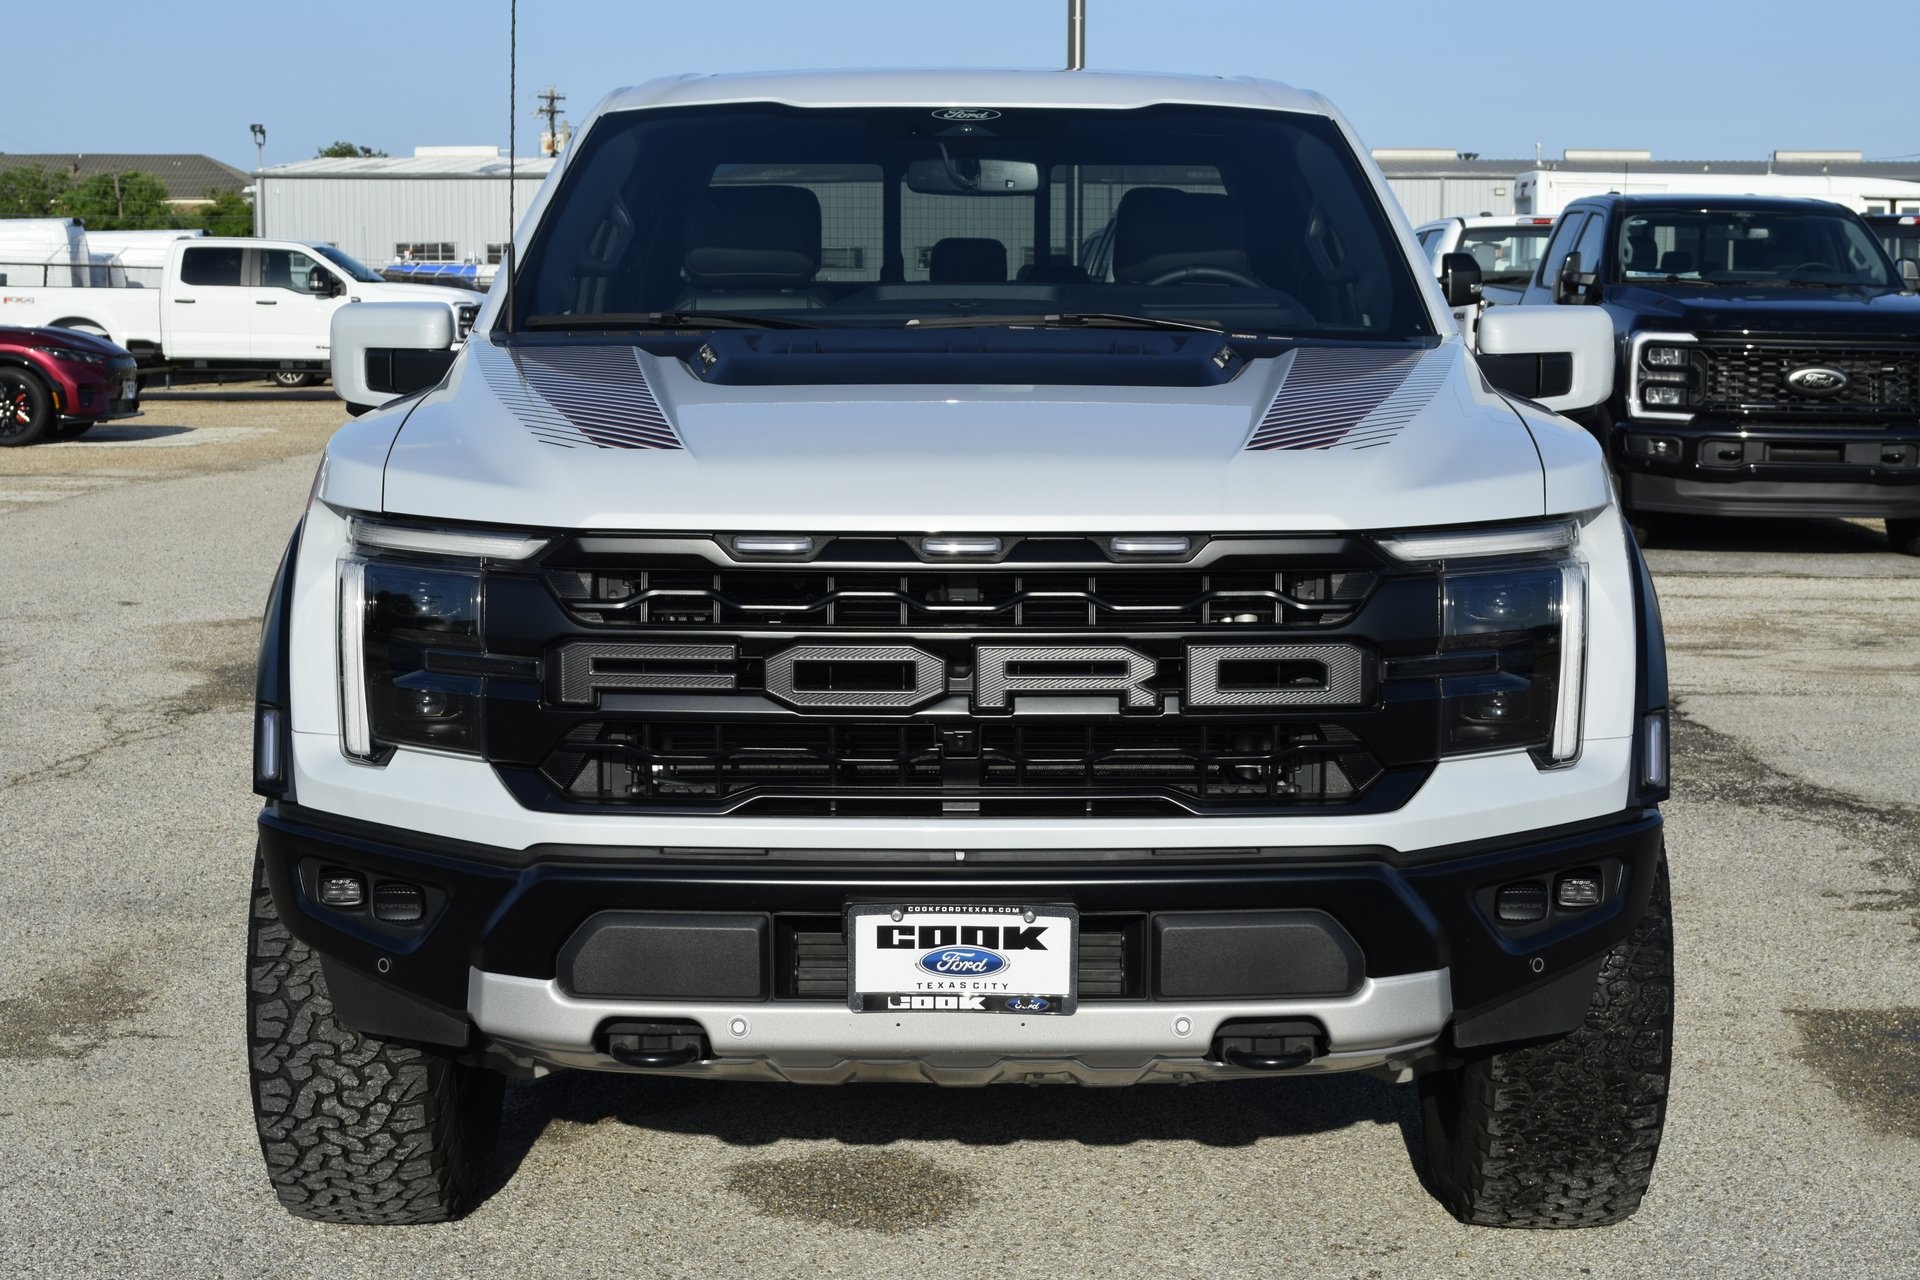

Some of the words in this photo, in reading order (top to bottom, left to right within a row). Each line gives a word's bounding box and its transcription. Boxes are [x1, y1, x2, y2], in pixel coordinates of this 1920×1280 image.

[943, 108, 988, 118] Ford
[3, 296, 35, 304] FX4
[1802, 373, 1834, 387] Ford
[555, 640, 1367, 713] FORD
[876, 925, 1049, 950] COOK
[936, 951, 988, 972] Ford
[916, 981, 967, 990] TEXAS
[972, 982, 1009, 990] CITY
[887, 996, 986, 1010] COOK
